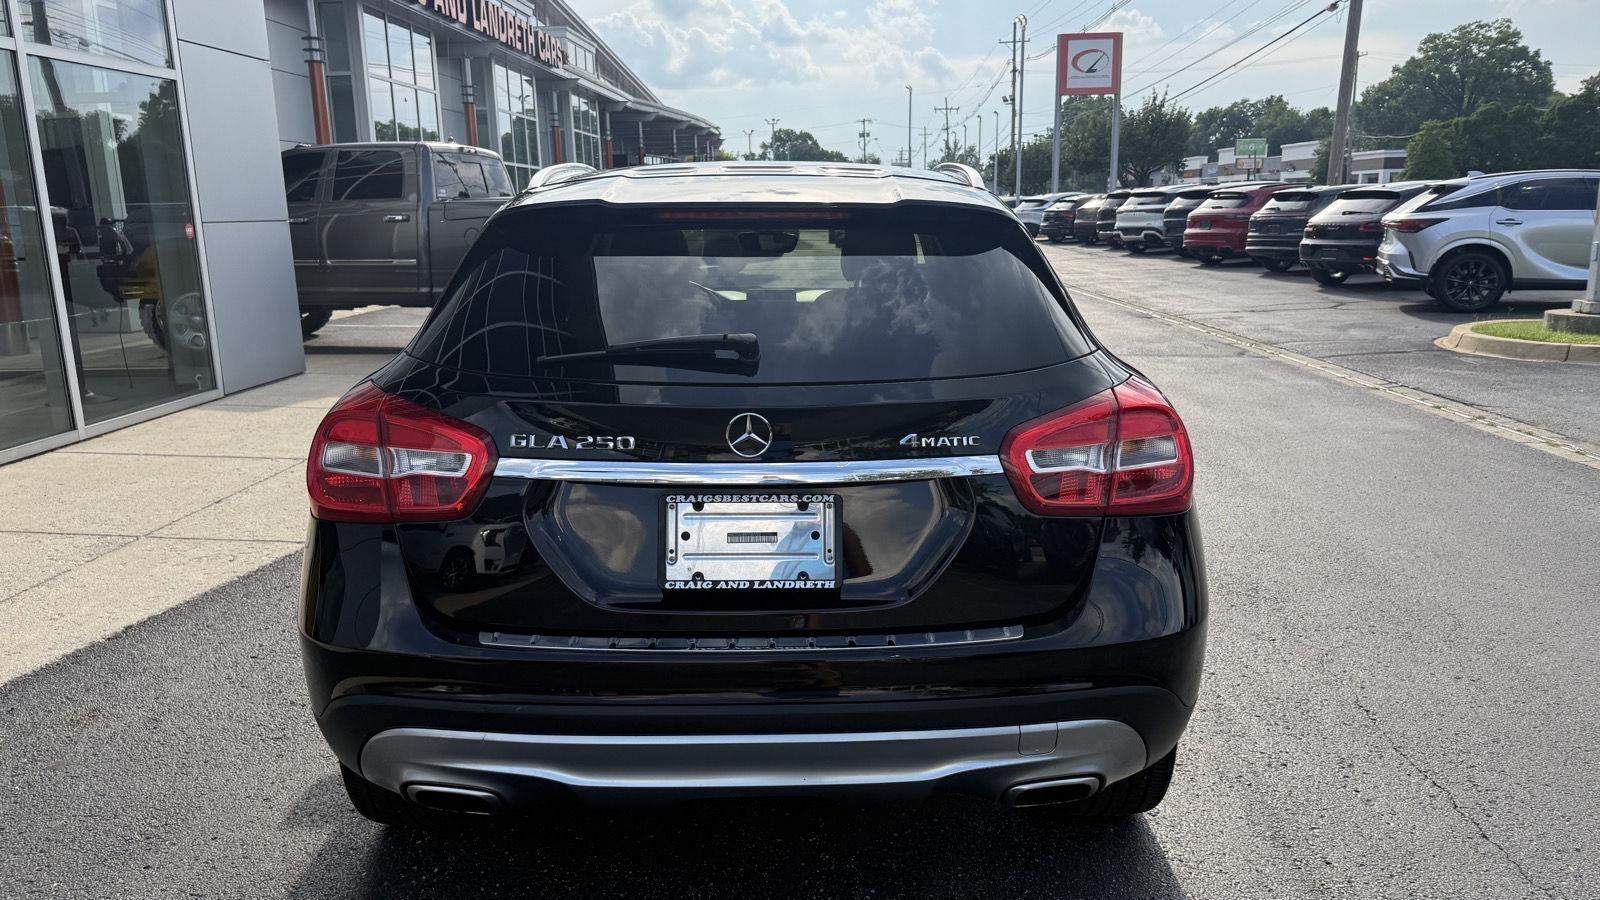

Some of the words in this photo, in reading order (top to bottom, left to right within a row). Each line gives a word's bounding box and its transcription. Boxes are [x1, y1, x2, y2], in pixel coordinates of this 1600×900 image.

[472, 0, 537, 57] LANDRETH
[537, 28, 563, 69] CARS
[510, 433, 569, 450] GLA
[576, 435, 636, 450] 250
[899, 433, 981, 448] 4MATIC
[665, 494, 835, 503] CRAIGSBESTCARS.COM
[664, 580, 714, 589] CRAIG
[716, 580, 750, 589] AND
[752, 580, 836, 589] LANDRETH
